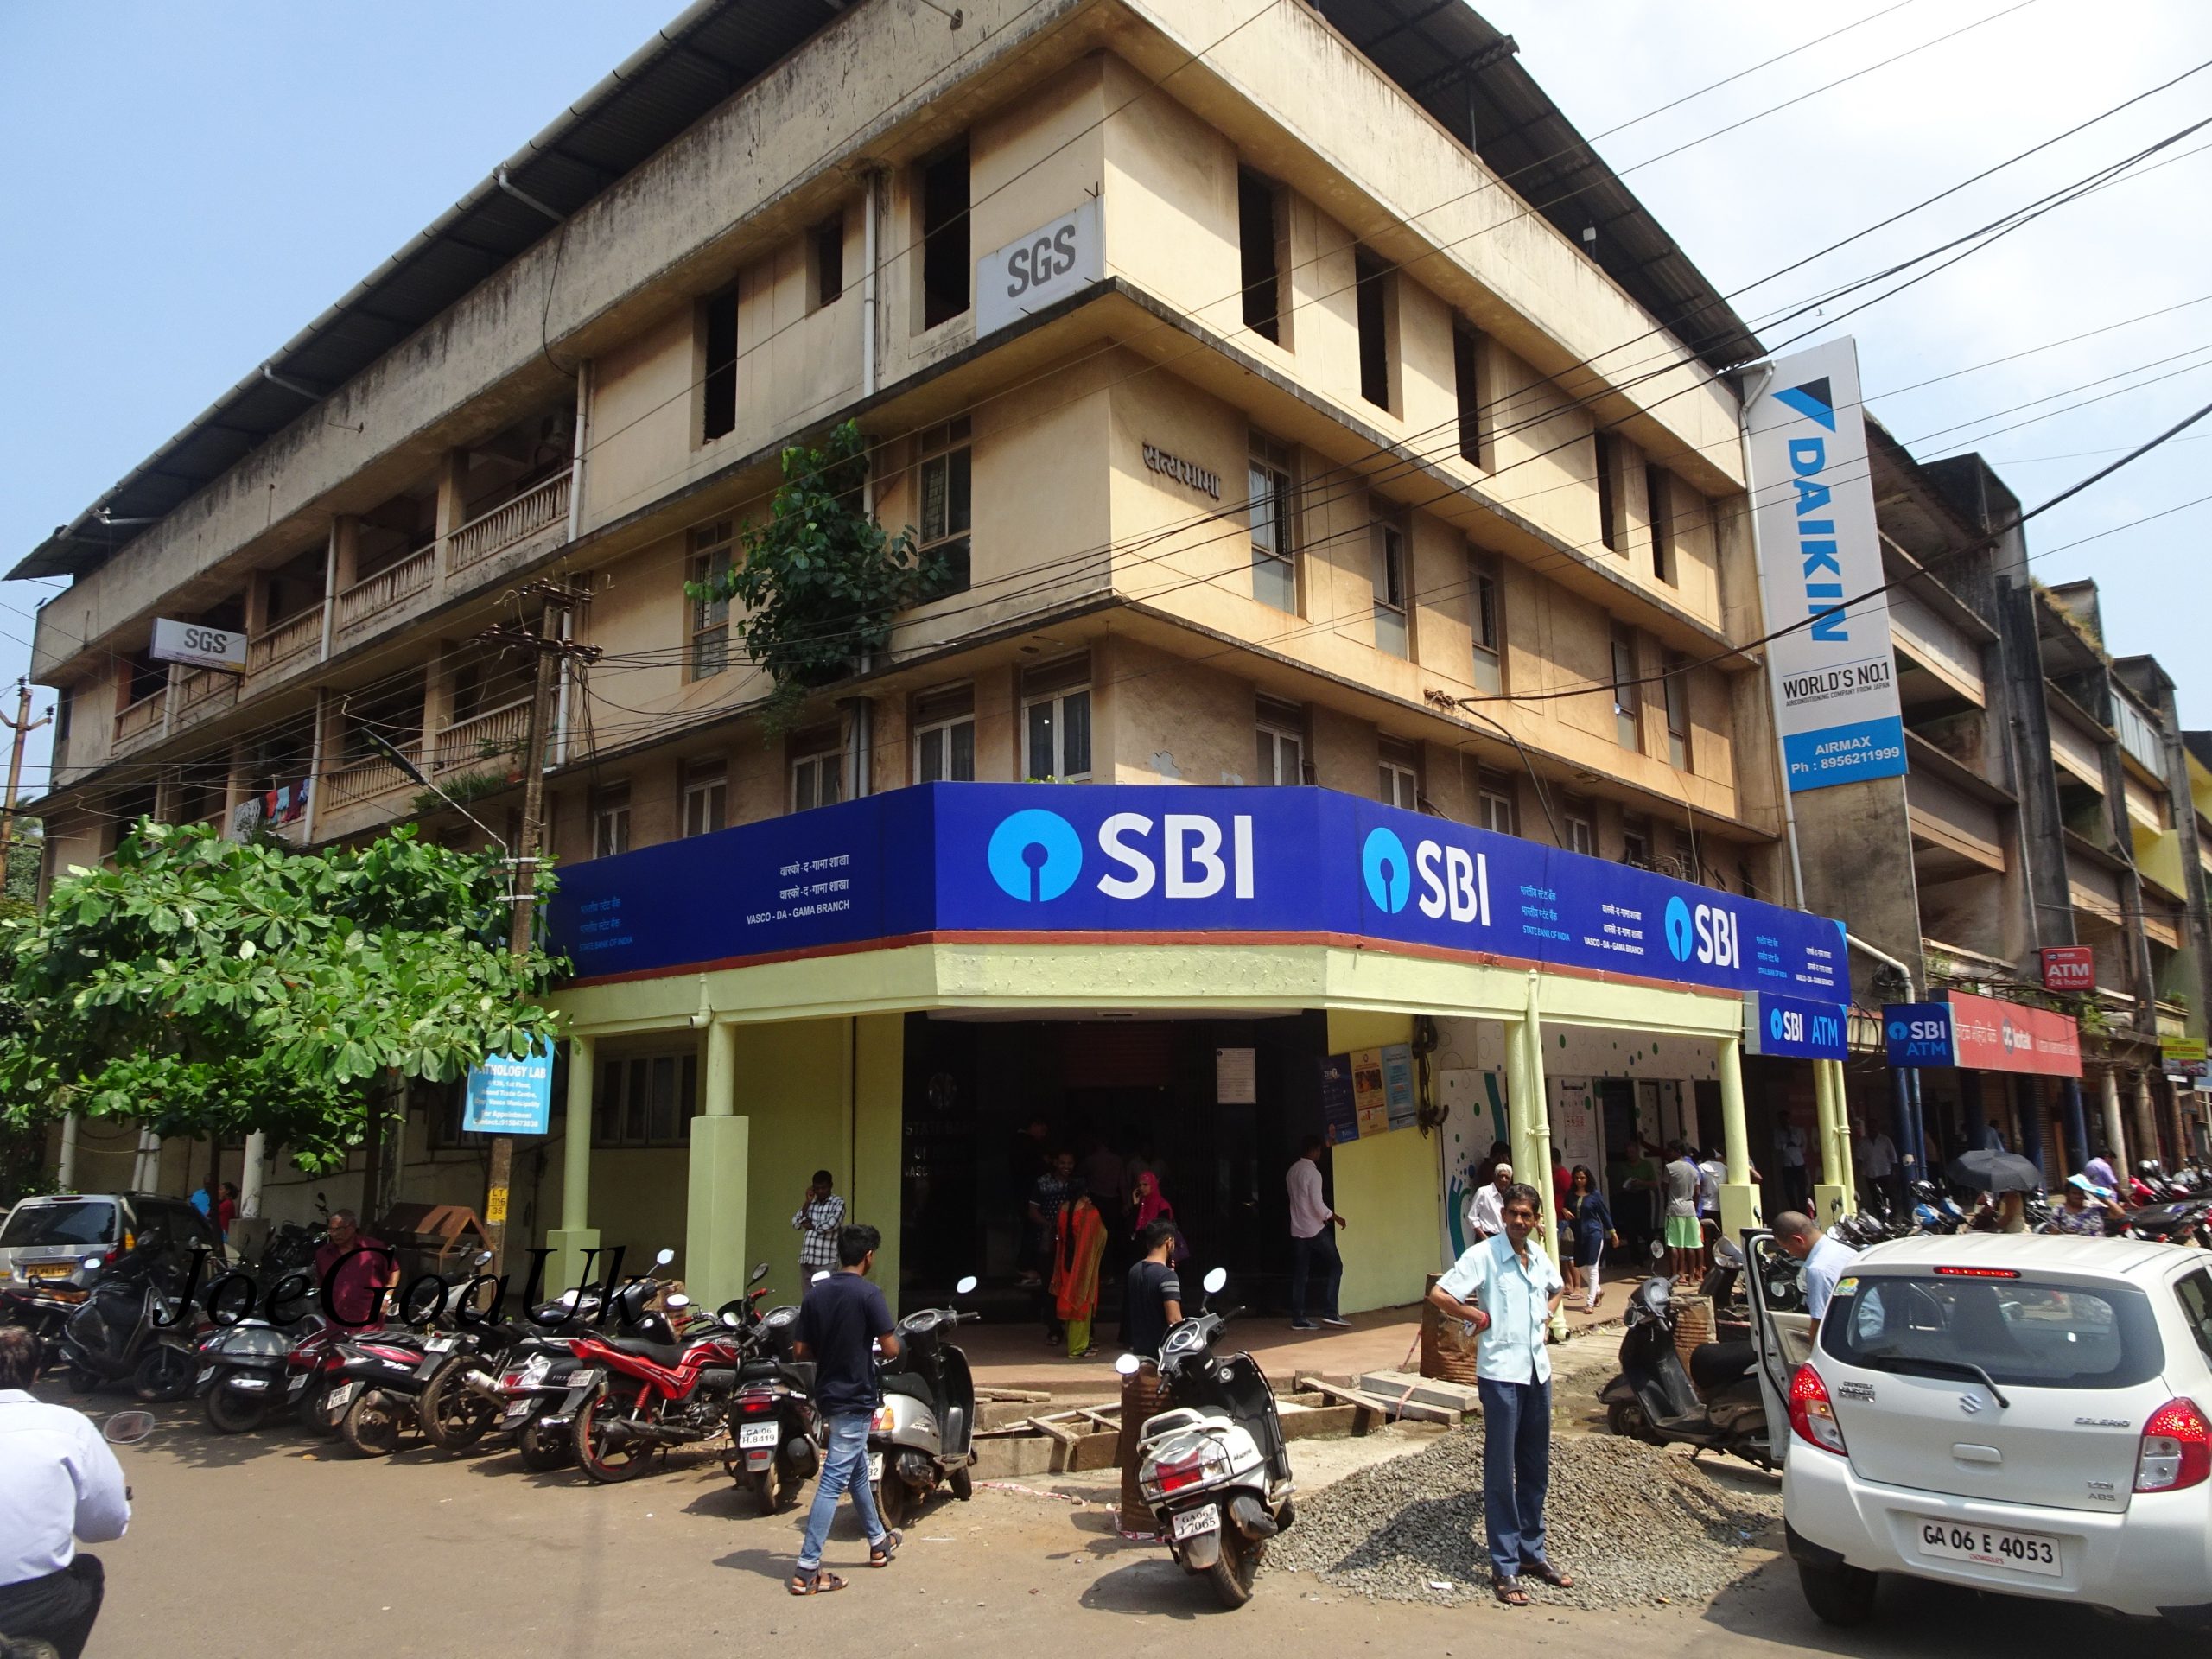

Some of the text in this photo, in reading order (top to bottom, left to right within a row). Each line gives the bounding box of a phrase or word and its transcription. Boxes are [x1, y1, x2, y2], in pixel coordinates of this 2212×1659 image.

[1007, 224, 1076, 298] SGS
[1788, 437, 1849, 642] DAIKIN
[184, 627, 227, 654] SGS
[1783, 669, 1853, 699] WORLD'S
[1815, 736, 1872, 755] AIRMAX
[1821, 747, 1900, 769] 8956211999
[1097, 812, 1254, 899] SBI
[1416, 840, 1491, 926] SBI
[747, 912, 772, 925] VASCO
[792, 906, 815, 918] GAMA
[817, 899, 849, 914] BRANCH
[1695, 904, 1739, 969] SBI
[2048, 963, 2088, 976] ATM
[1783, 1011, 1838, 1046] SBI ATM
[1910, 1021, 1946, 1039] SBI
[1906, 1041, 1947, 1056] ATM
[529, 1067, 547, 1078] LAB
[2088, 1493, 2115, 1502] ABS
[1923, 1524, 2054, 1563] GA 06 E 4053
